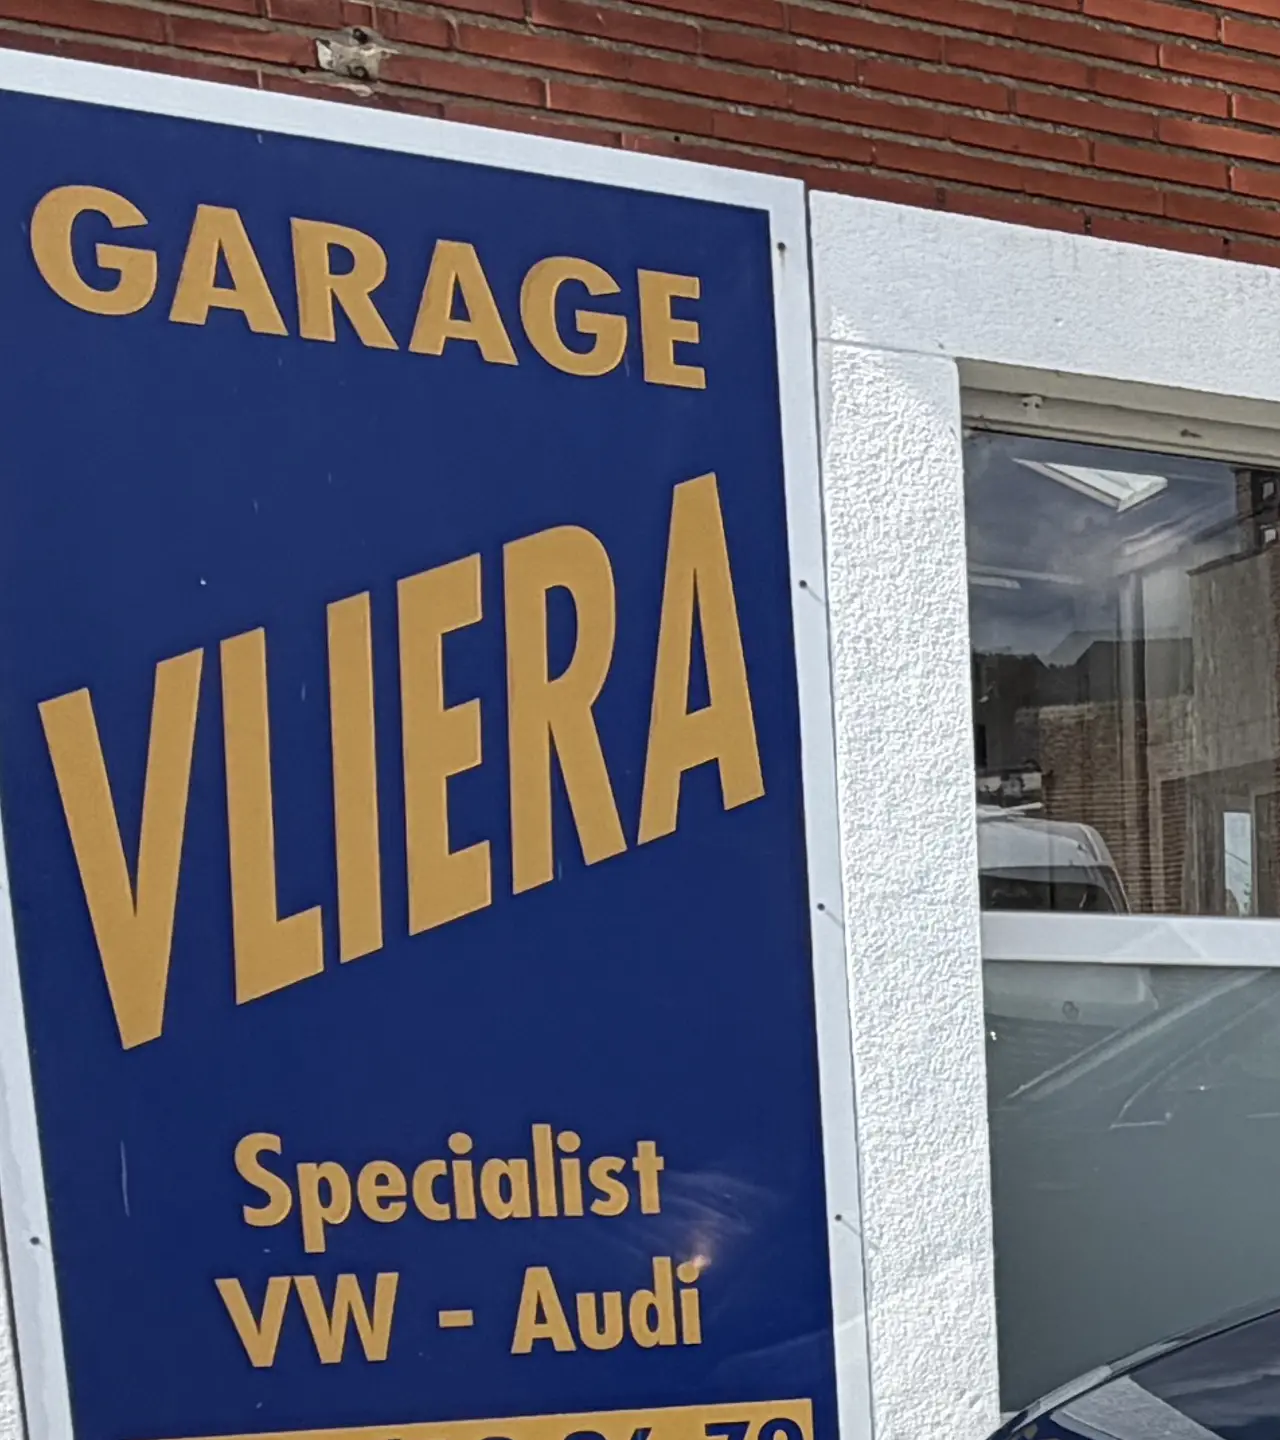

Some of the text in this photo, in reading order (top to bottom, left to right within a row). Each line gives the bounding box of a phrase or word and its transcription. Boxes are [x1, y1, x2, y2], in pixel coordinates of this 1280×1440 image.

[30, 184, 706, 390] GARAGE
[37, 470, 765, 1051] VLIERA
[232, 1123, 665, 1254] Specialist
[214, 1256, 704, 1368] VW - Audi
